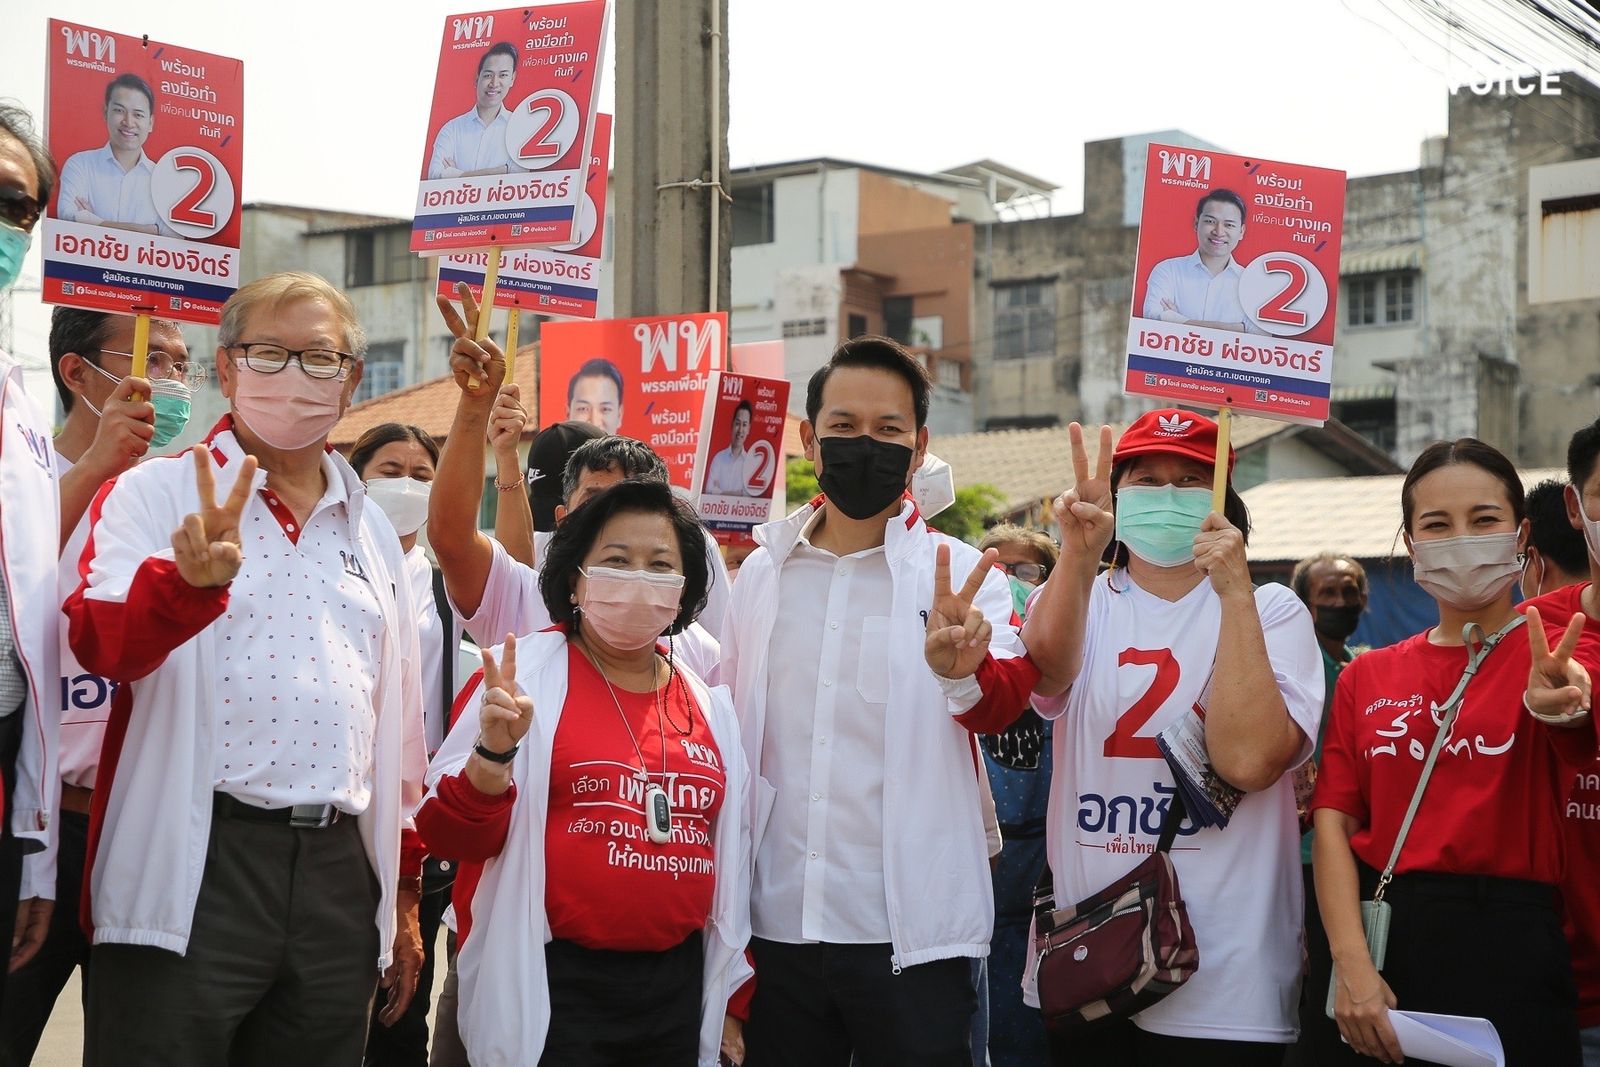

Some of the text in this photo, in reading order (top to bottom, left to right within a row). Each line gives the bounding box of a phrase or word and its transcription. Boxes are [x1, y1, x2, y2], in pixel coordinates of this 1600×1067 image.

[453, 15, 494, 41] พท
[529, 16, 567, 31] พร้อม!
[61, 26, 116, 63] พท
[525, 33, 574, 49] ลงมือทำ
[66, 57, 115, 74] พรรคเพื่อไทย
[161, 58, 205, 79] พร้อม!
[522, 50, 588, 67] เพื่อคนบางแค
[555, 66, 574, 77] ทันที
[161, 80, 217, 103] ลงมือทำ
[160, 102, 235, 127] เพื่อคนบางแค
[200, 125, 221, 138] ทันที
[518, 95, 564, 159] 2
[1159, 150, 1212, 180] พท
[169, 153, 216, 229] 2
[423, 175, 571, 207] เอกชัย ผ่องจิตร์
[1161, 177, 1209, 190] พรรคเพื่อไทย
[1256, 173, 1302, 191] พร้อม!
[1254, 192, 1313, 211] ลงมือทำ
[1252, 211, 1332, 233] เพื่อคนบางแค
[1292, 232, 1315, 244] ทันที
[55, 233, 231, 278] เอกชัย ผ่องจิตร์
[102, 270, 131, 284] ผู้สมัคร
[514, 253, 593, 281] ผ่องจิตร์
[1257, 258, 1308, 327] 2
[634, 319, 721, 373] พท
[1139, 330, 1323, 373] เอกชัย ผ่องจิตร์
[1185, 365, 1214, 377] ผู้สมัคร
[723, 376, 743, 395] พท
[651, 409, 690, 425] พร้อม!
[748, 446, 768, 487] 2
[701, 500, 768, 517] เอกชัย ผ่องจิตร์
[1103, 647, 1181, 759] 2
[681, 739, 719, 768] พท
[571, 775, 610, 795] เลือก
[567, 818, 606, 835] เลือก
[1105, 834, 1157, 854] เพื่อไทย
[608, 841, 714, 881] ให้คนกรุงเทพฯ
